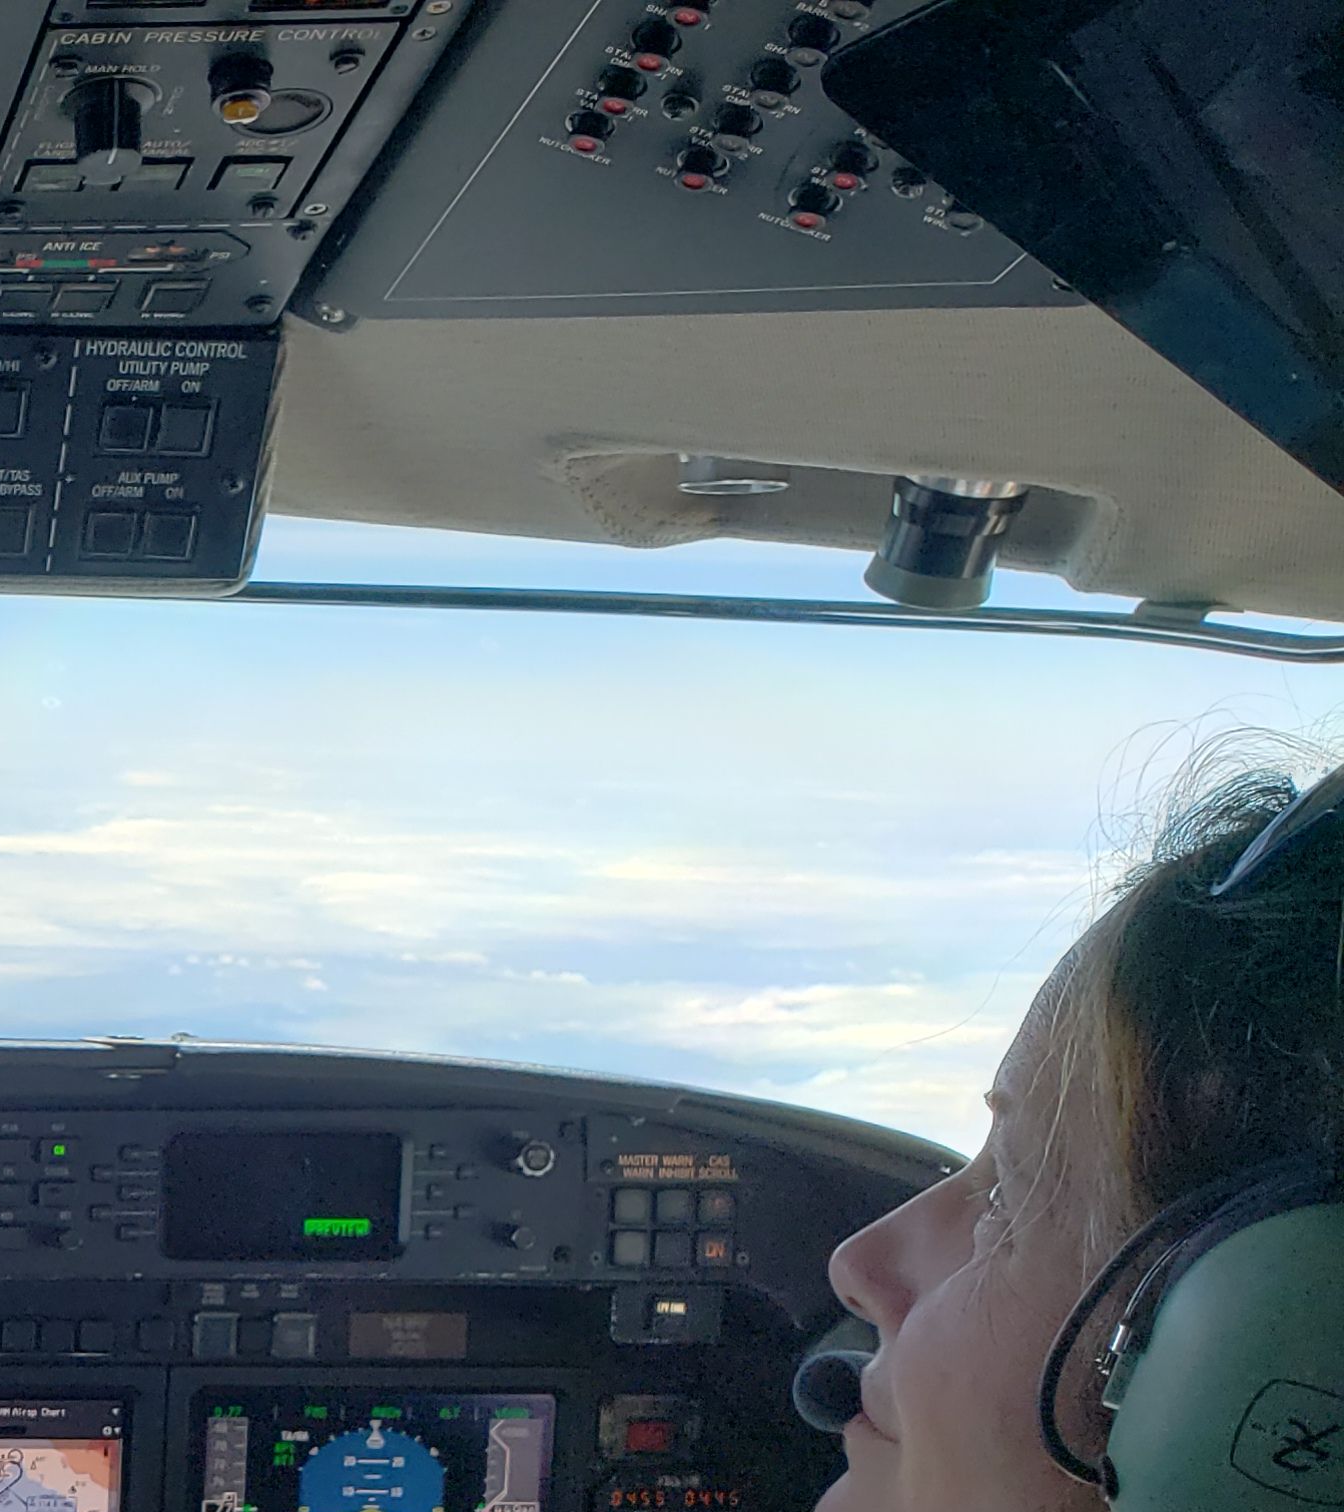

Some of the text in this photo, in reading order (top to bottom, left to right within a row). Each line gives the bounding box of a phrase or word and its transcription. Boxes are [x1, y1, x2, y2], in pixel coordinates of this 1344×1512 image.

[60, 29, 383, 46] CABIN PRESSURE CONTROL
[43, 242, 103, 252] ANTI ICE
[86, 340, 247, 359] HYDRAULIC CONTROL
[119, 361, 209, 375] UTILITY PUMP
[106, 379, 160, 392] OFF/ARM
[181, 380, 200, 393] ON
[118, 471, 179, 485] AUX PUMP
[0, 483, 42, 497] BYPASS
[91, 484, 144, 498] OFF/ARM
[165, 486, 184, 499] ON
